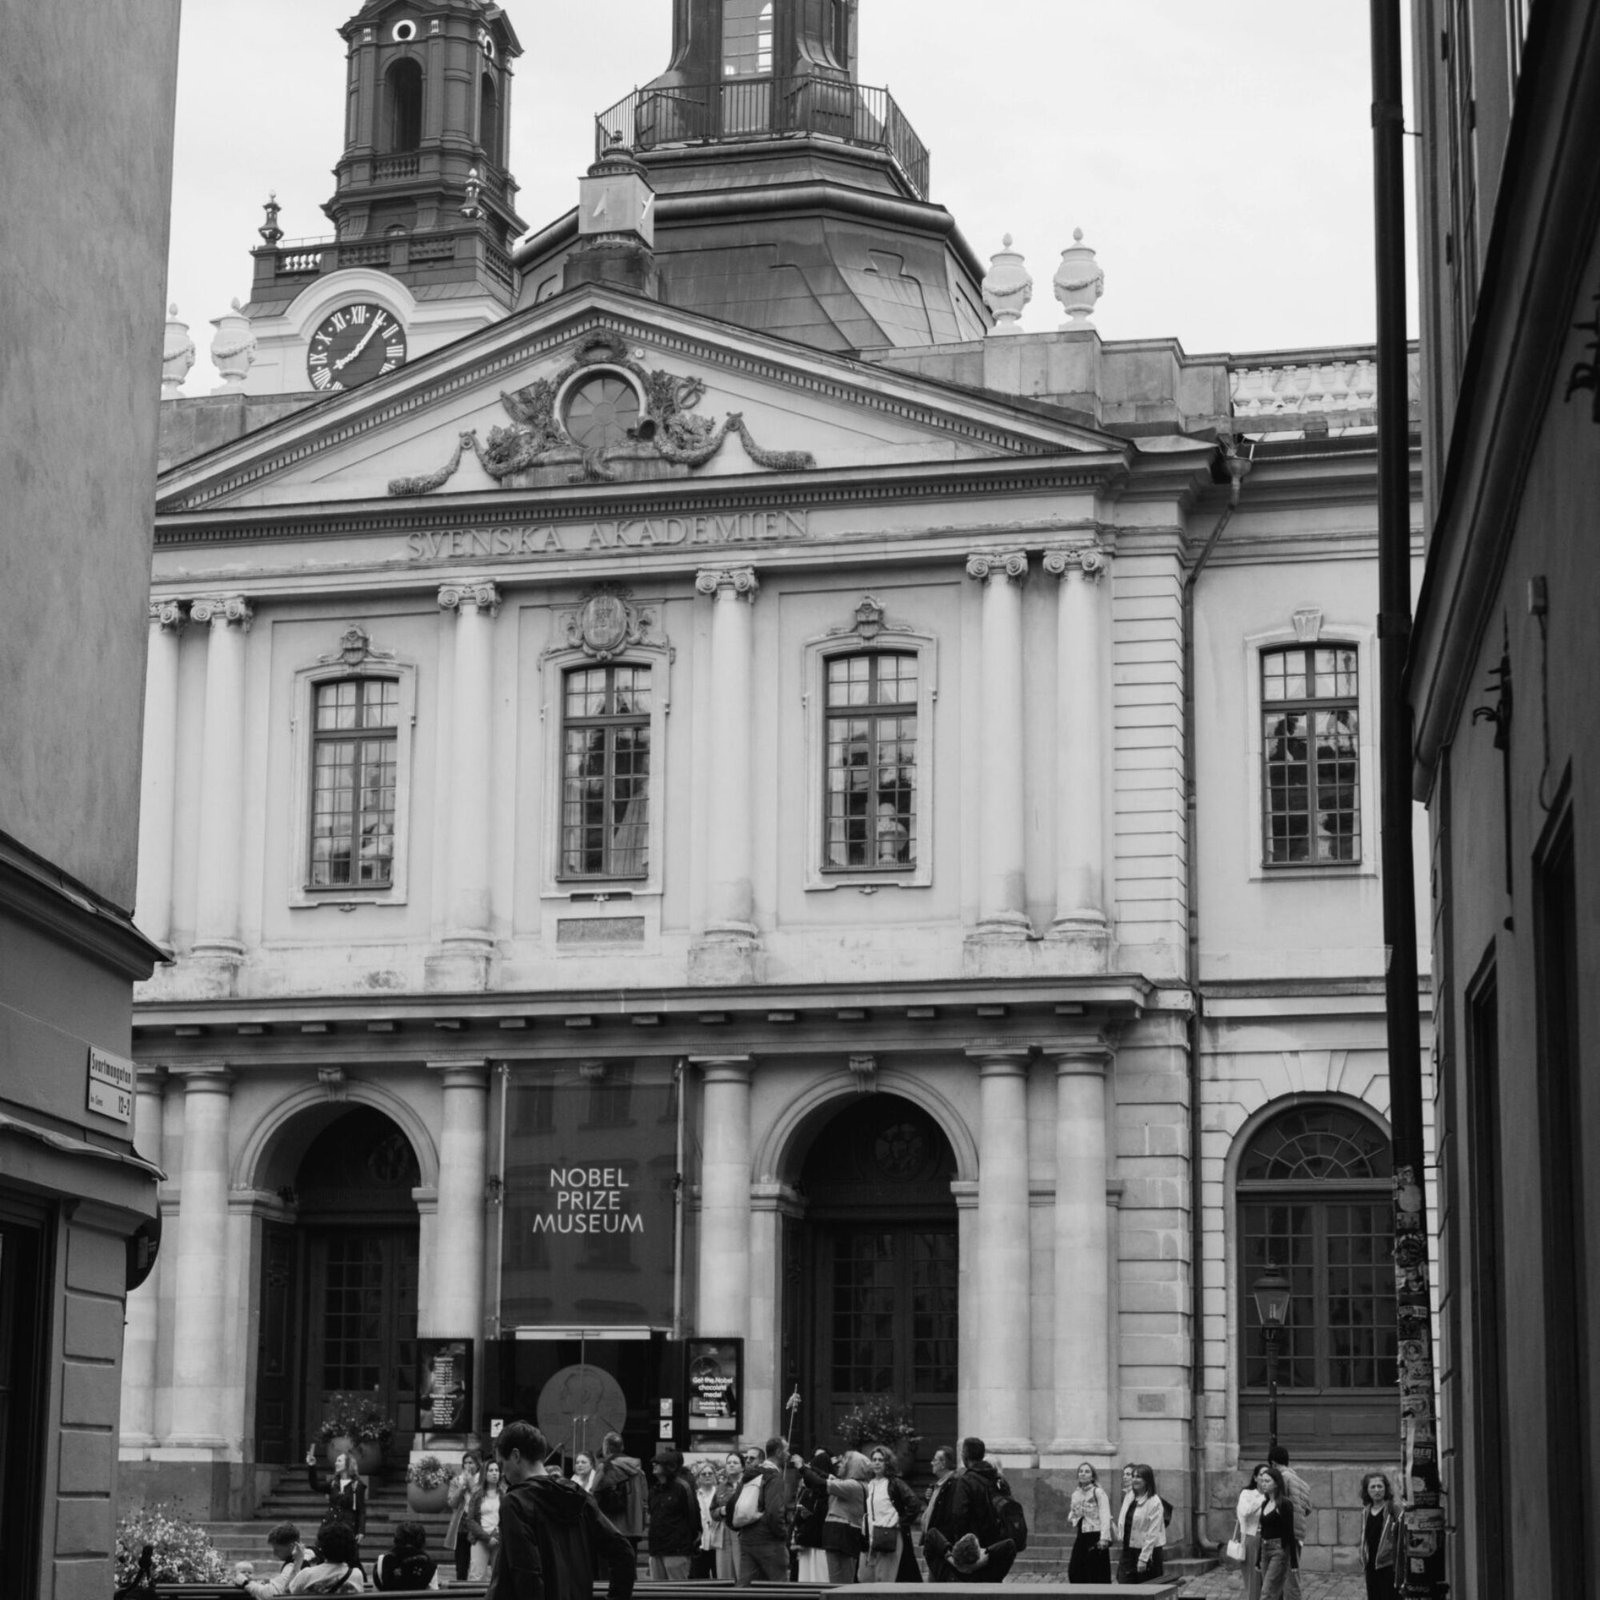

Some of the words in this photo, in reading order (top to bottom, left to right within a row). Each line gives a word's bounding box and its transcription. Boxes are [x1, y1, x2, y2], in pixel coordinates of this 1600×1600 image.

[330, 312, 347, 332] XI
[351, 305, 366, 324] XII
[315, 331, 333, 345] X
[382, 323, 399, 339] II
[309, 352, 328, 365] IX
[386, 344, 404, 357] III
[407, 526, 564, 559] SVENSKA
[587, 510, 810, 551] AKADEMIEN
[550, 1168, 629, 1187] NOBEL
[557, 1191, 620, 1210] PRIZE
[532, 1213, 644, 1233] MUSEUM
